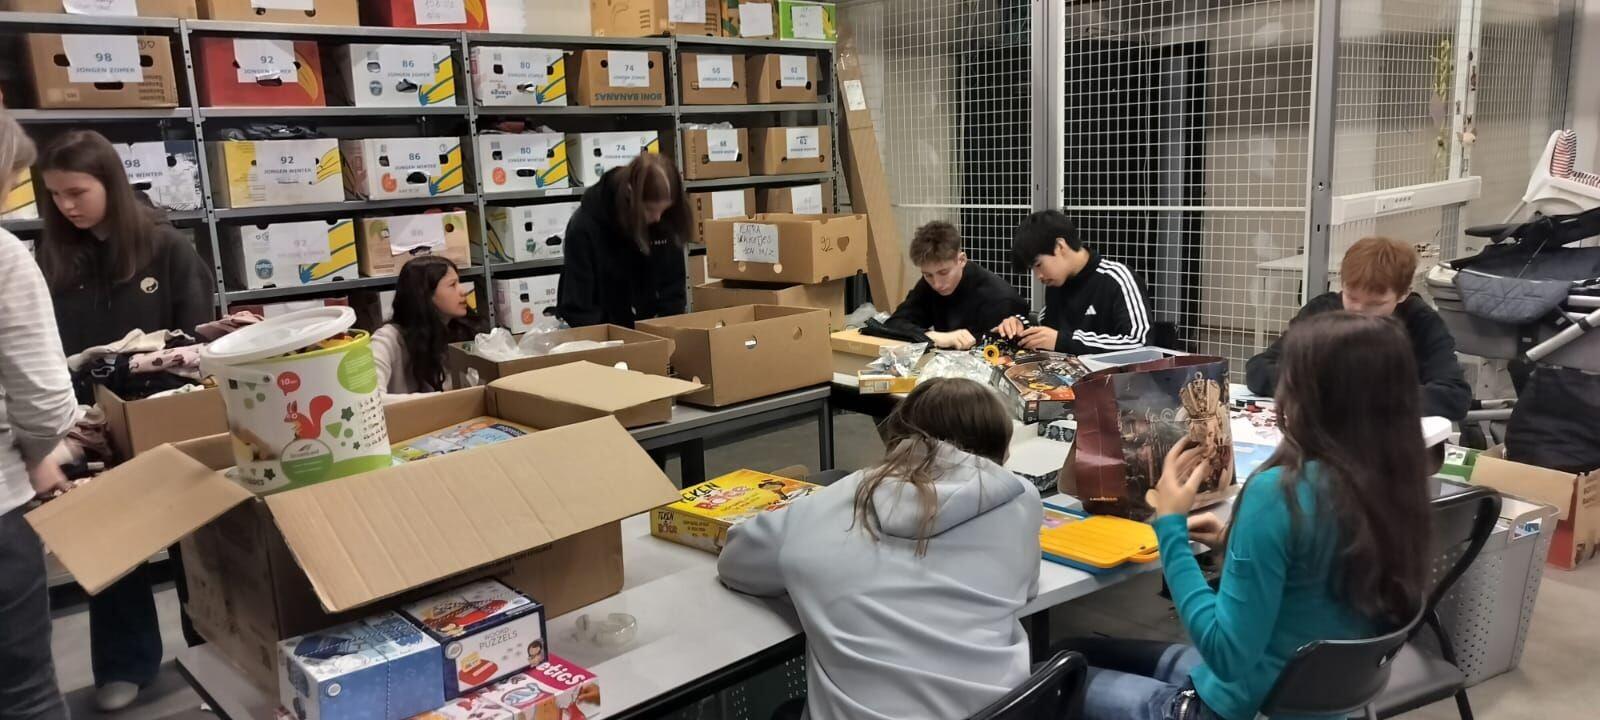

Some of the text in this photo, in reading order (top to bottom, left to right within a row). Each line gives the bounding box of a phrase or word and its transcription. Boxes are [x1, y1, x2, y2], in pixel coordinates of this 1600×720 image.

[95, 52, 113, 62] 98
[260, 55, 274, 64] 92
[402, 59, 415, 68] 86
[519, 61, 531, 70] 80
[624, 64, 635, 72] 74
[594, 91, 662, 101] BONI BANANAS
[520, 146, 532, 154] 80
[280, 155, 294, 165] 92
[408, 152, 421, 161] 86
[124, 158, 141, 169] 98
[135, 171, 163, 179] WINTER
[479, 630, 518, 650] PUZZELS
